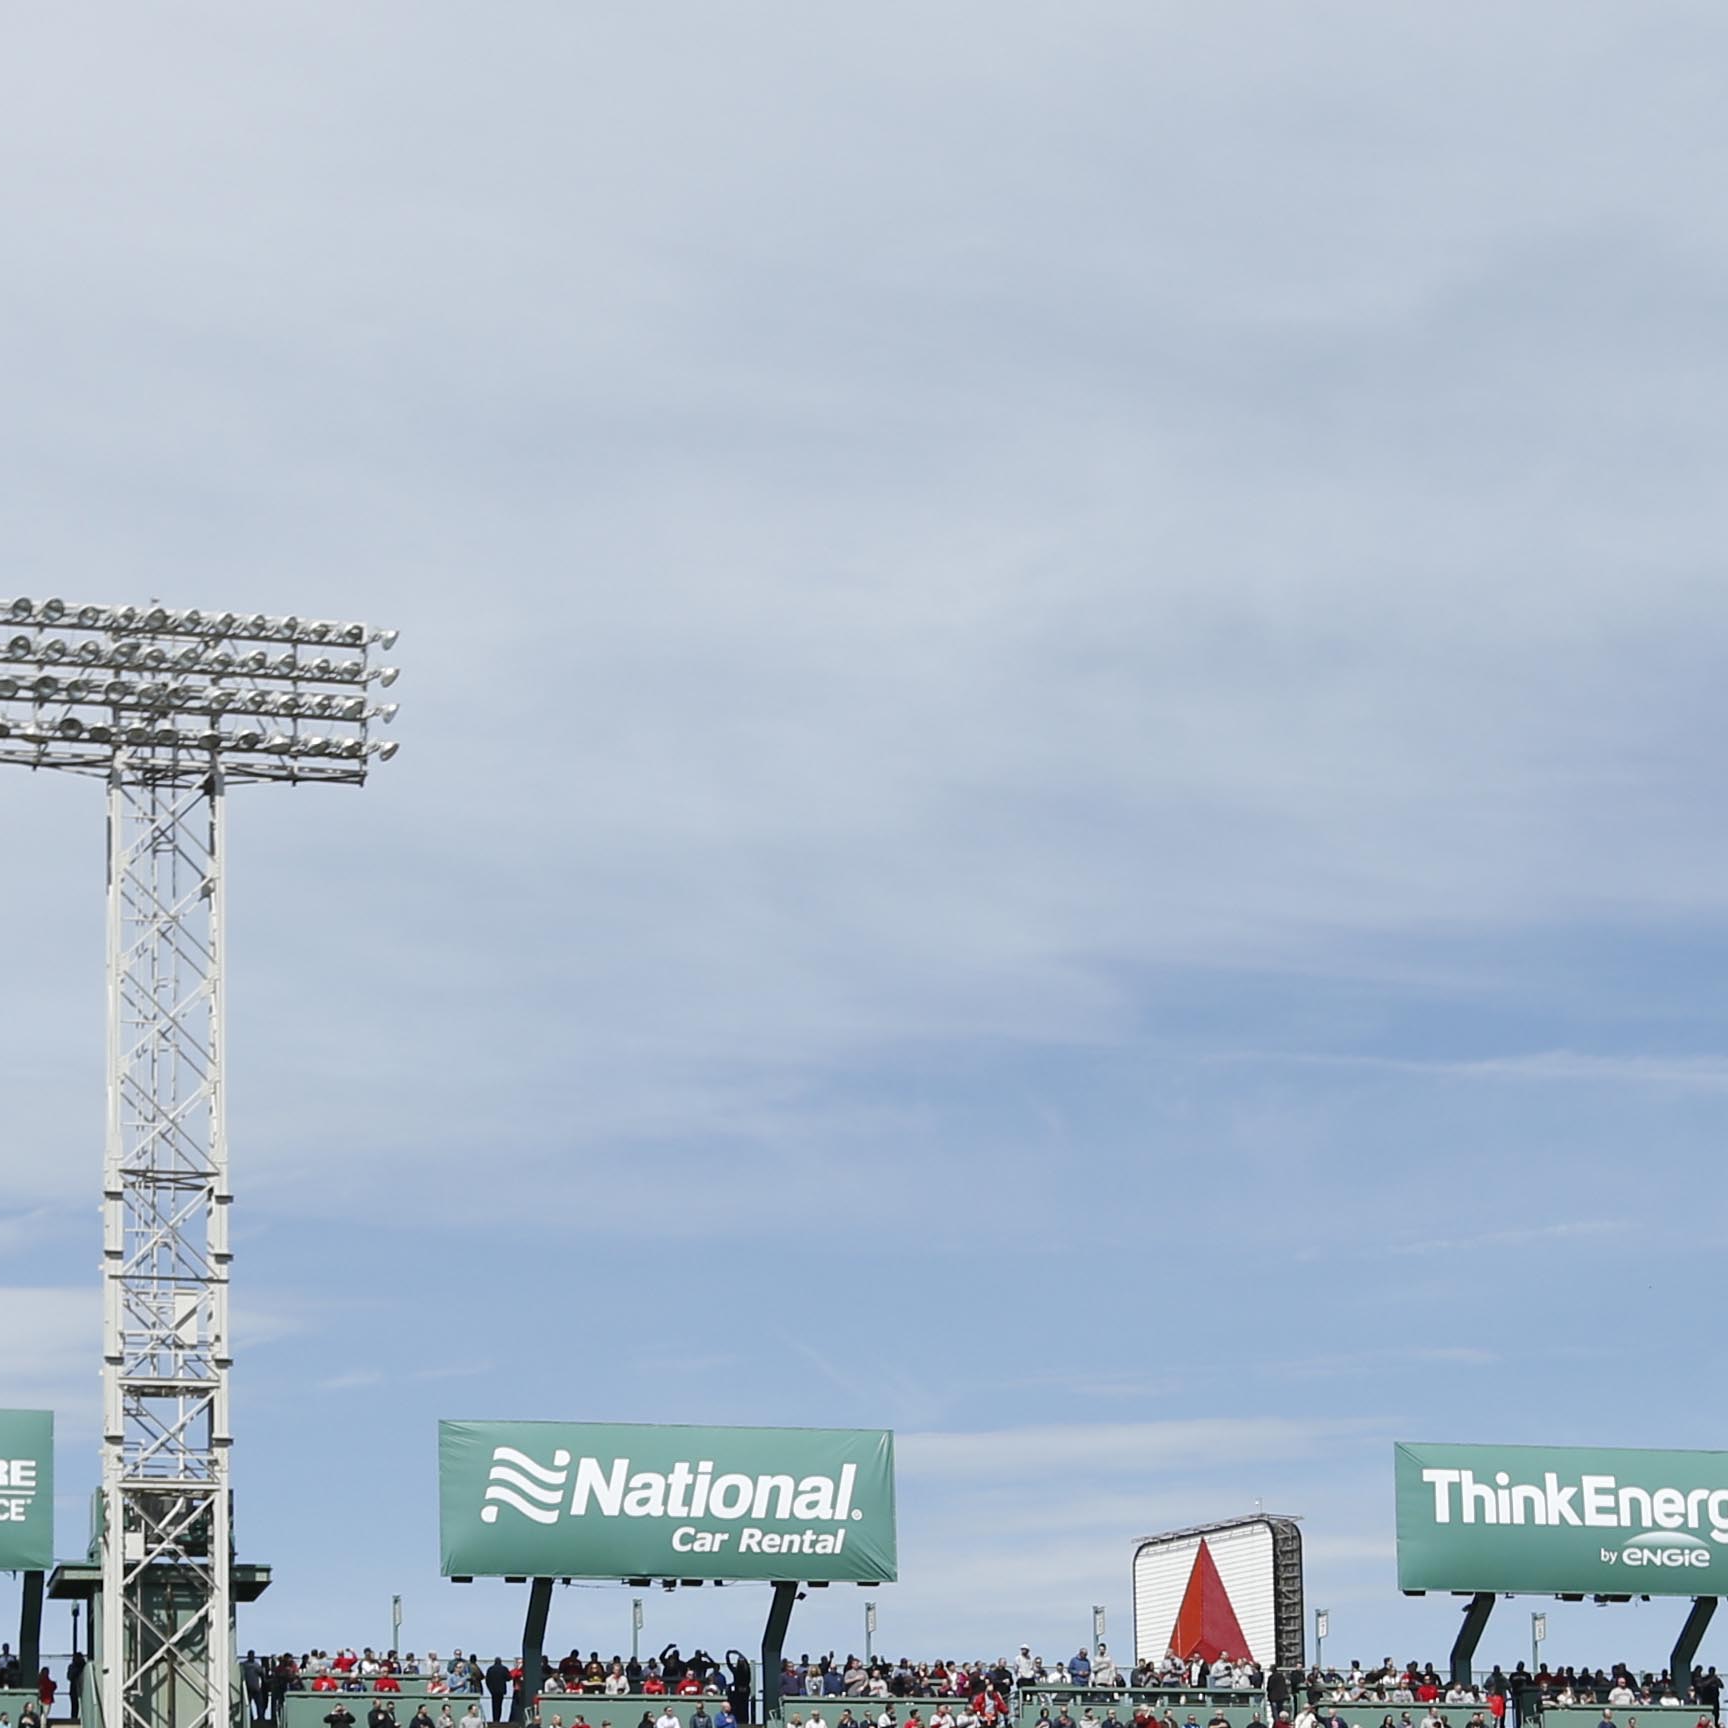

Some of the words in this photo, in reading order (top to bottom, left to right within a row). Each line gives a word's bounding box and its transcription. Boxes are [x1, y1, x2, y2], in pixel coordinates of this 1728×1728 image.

[569, 1456, 859, 1522] National
[671, 1526, 729, 1554] Car
[738, 1527, 847, 1556] Rental
[1600, 1548, 1619, 1566] by
